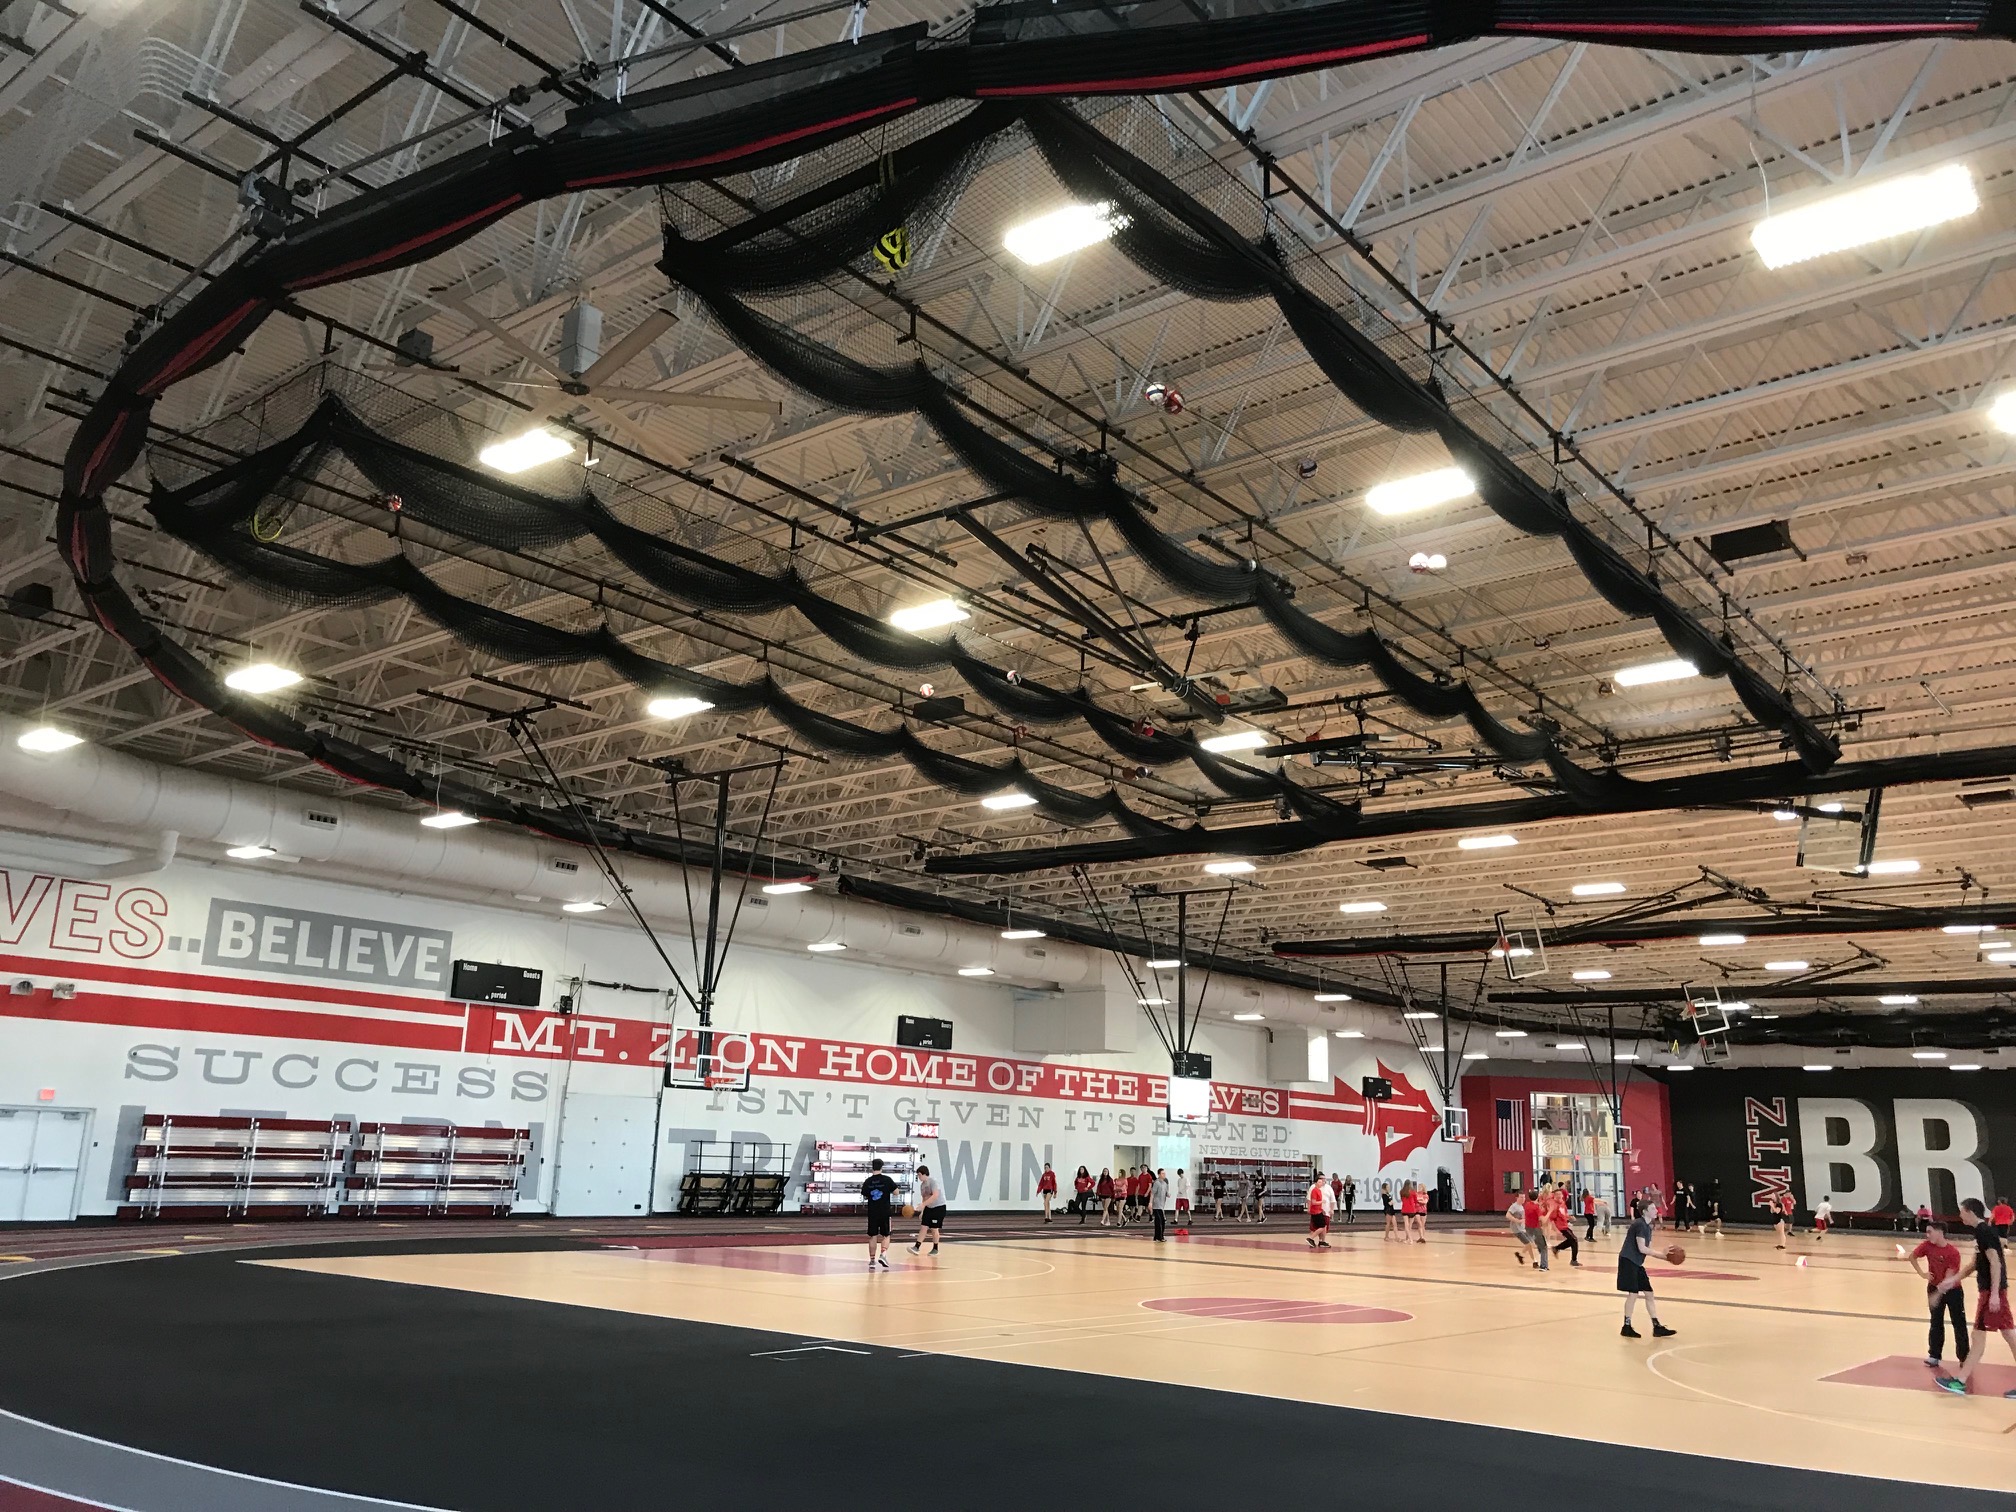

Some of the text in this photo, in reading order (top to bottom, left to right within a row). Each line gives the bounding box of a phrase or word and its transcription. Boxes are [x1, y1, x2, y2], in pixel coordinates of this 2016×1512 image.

[217, 910, 444, 982] BELIEVE
[462, 962, 478, 972] Home
[124, 1043, 549, 1102] SUCCESS
[705, 1087, 869, 1120] ISN'T
[893, 1097, 1044, 1129] GIVEN
[1064, 1109, 1136, 1135] IT'S
[493, 1012, 629, 1061] MT.
[818, 1043, 977, 1087] HOME
[987, 1061, 1044, 1092] OF
[1055, 1068, 1139, 1102] THE
[1147, 1077, 1280, 1115] BAVES
[668, 1127, 1053, 1203] TRA WIN
[1198, 1144, 1300, 1159] NEVER GIVE UP
[1745, 1096, 1792, 1208] MTZ
[1797, 1097, 1995, 1218] BR
